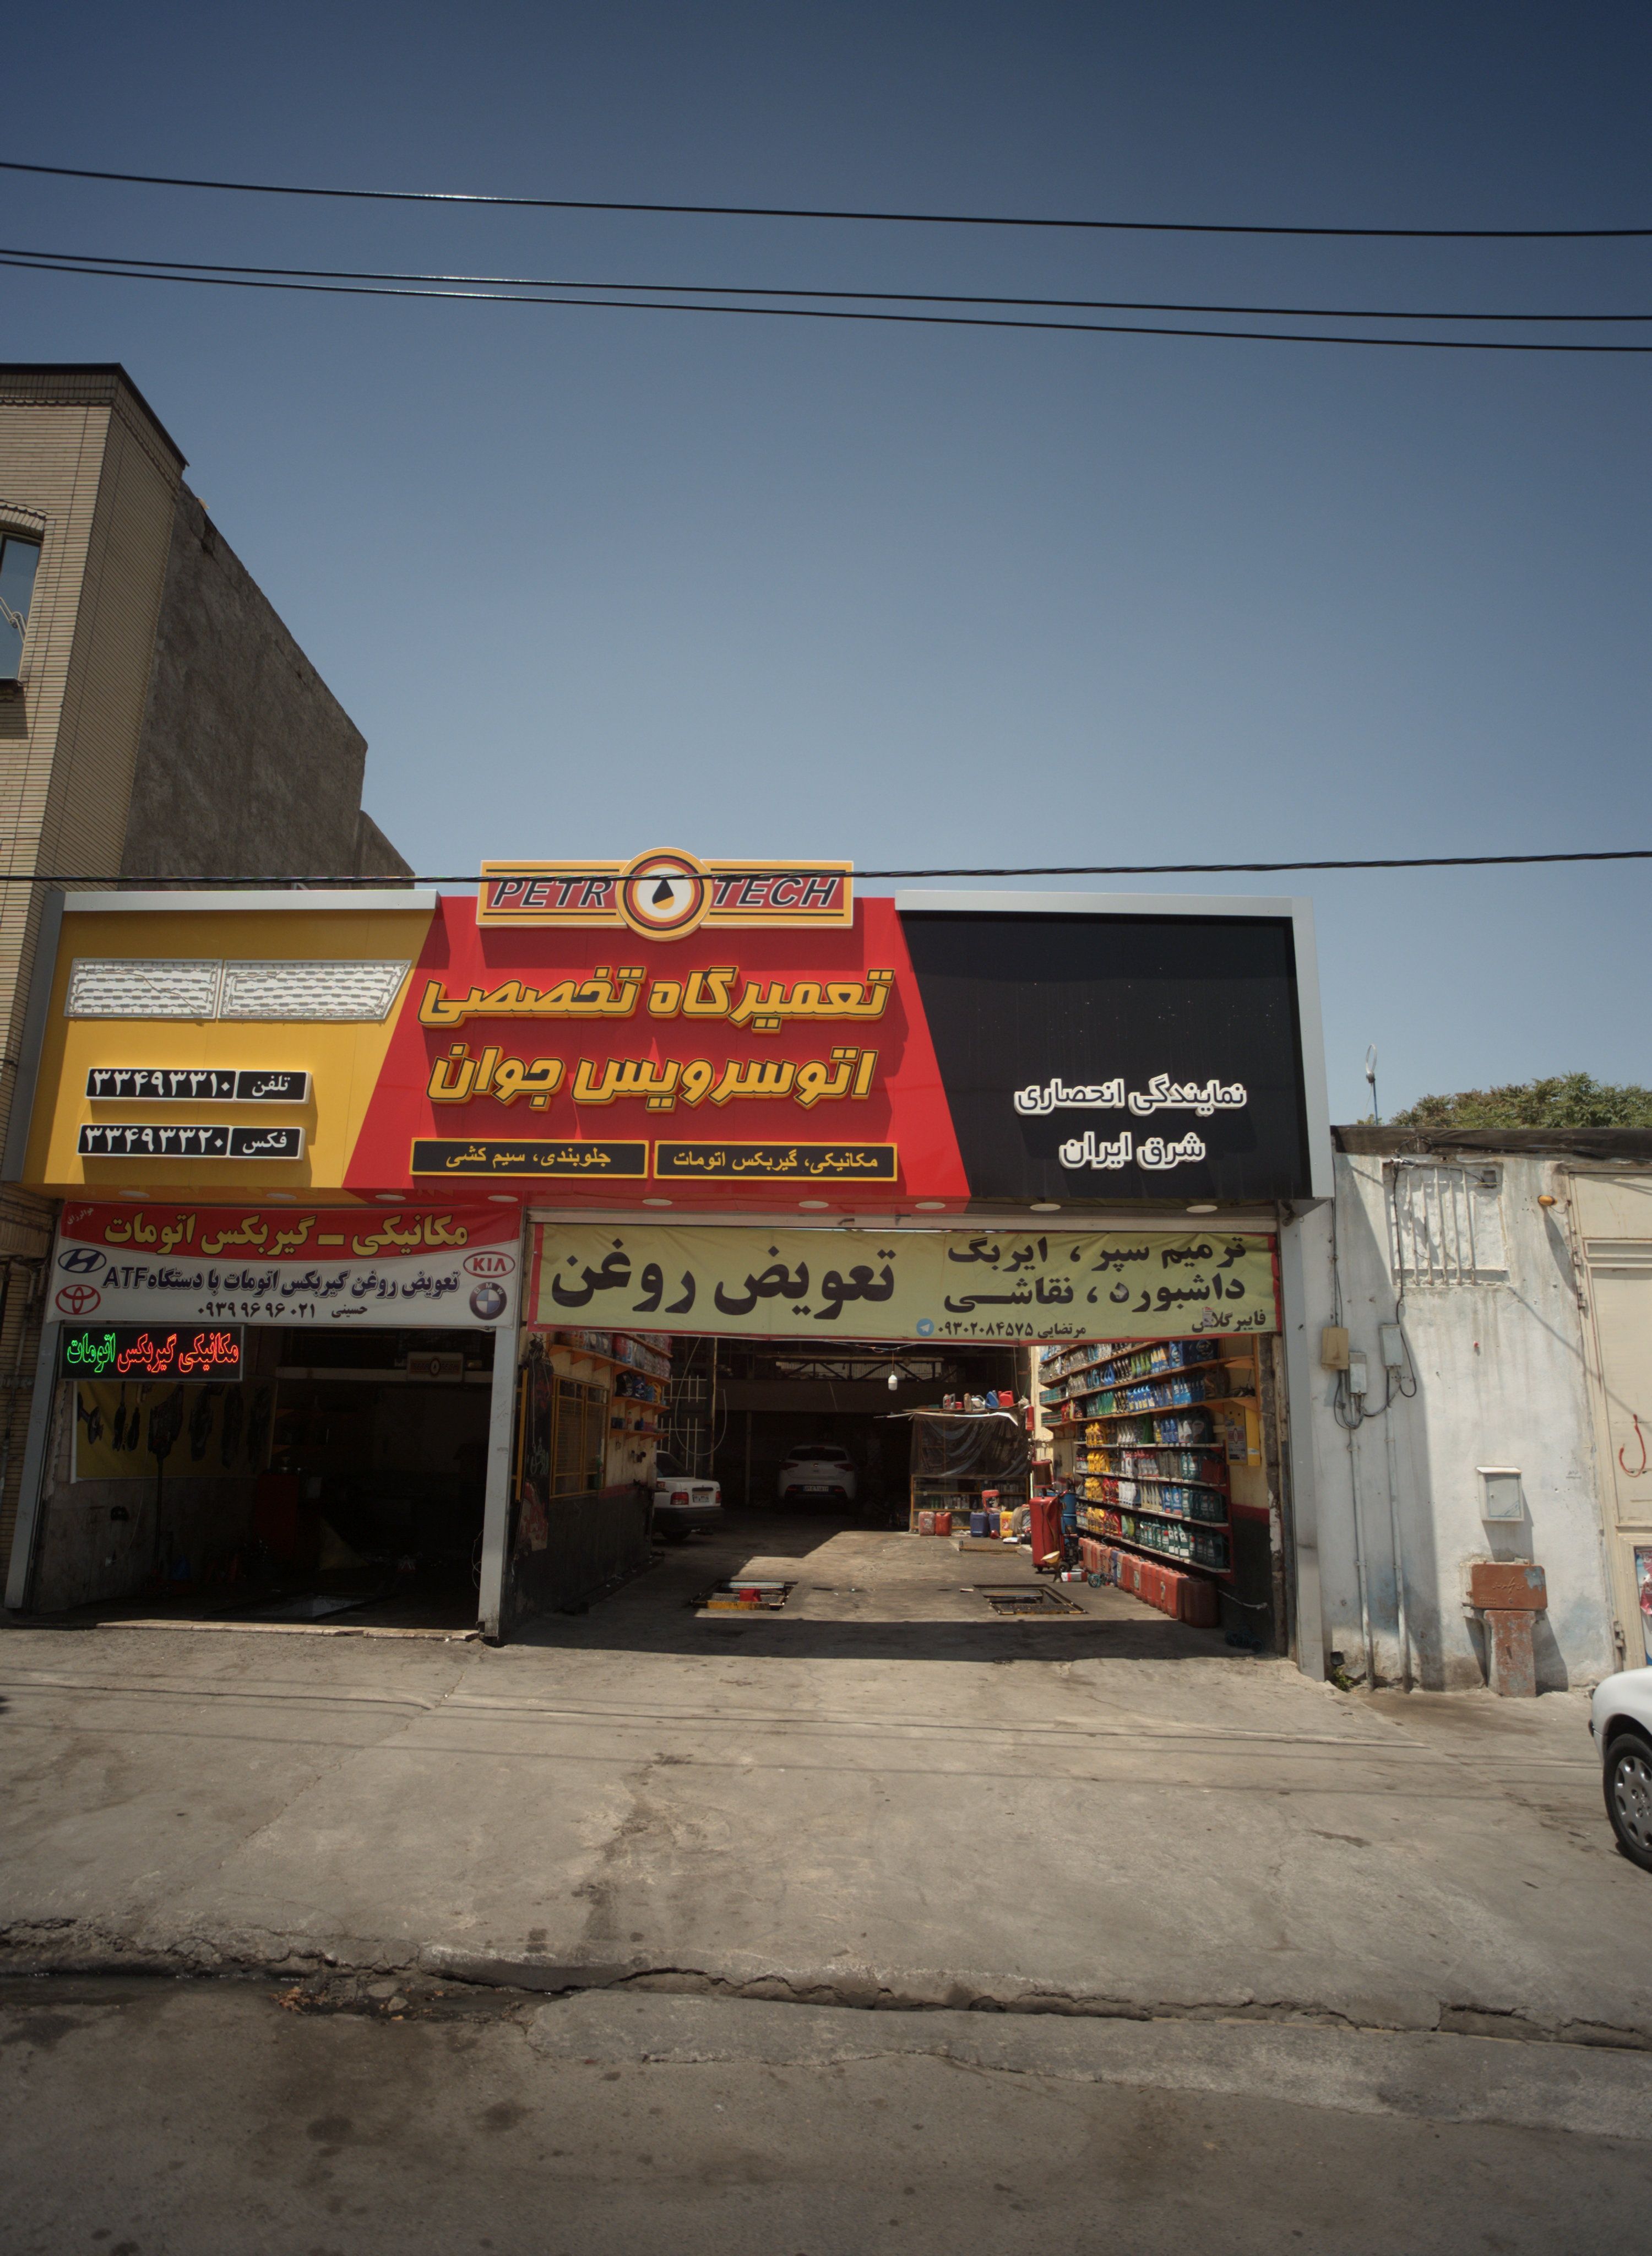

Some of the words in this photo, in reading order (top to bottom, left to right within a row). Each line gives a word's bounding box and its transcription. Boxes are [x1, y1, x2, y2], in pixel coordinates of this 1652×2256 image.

[713, 875, 841, 908] TECH
[417, 966, 646, 1028] تخصصی
[646, 966, 895, 1034] تعمیرگاه
[92, 1070, 231, 1098] ۳۳۴۹۳۳۱۰
[251, 1076, 291, 1097] تلفن
[426, 1042, 567, 1111] جوان
[1013, 1078, 1126, 1116] انحصاری
[1128, 1073, 1247, 1117] نمایندگی
[85, 1127, 224, 1153] ۳۳۴۹۳۳۲۰
[242, 1132, 287, 1153] فکس
[1058, 1131, 1132, 1169] ایران
[1137, 1131, 1205, 1170] شرق
[445, 1146, 487, 1168] کشی
[492, 1152, 526, 1168] سیم
[672, 1152, 726, 1169] اتومات
[732, 1148, 797, 1172] گیربکس
[103, 1211, 197, 1255] اتومات
[200, 1214, 317, 1256] گیربکس
[351, 1213, 469, 1256] مکانیکی
[472, 1257, 507, 1272] KIA
[948, 1237, 1048, 1272] ایربگ
[1161, 1236, 1247, 1269] ترمیم
[102, 1266, 149, 1288] ATF
[147, 1267, 203, 1290] دستگاه
[207, 1268, 222, 1296] با
[224, 1267, 280, 1297] اتومات
[280, 1268, 351, 1299] گیربکس
[351, 1270, 396, 1298] روغن
[402, 1270, 461, 1299] تعویض
[473, 1282, 505, 1295] BMW
[551, 1238, 696, 1314] روغن
[713, 1245, 897, 1320] تعویض
[943, 1277, 1074, 1313] نقاشی
[332, 1304, 368, 1318] حسینی
[1233, 1309, 1267, 1332] فایبر
[938, 1321, 1034, 1337] ۰۹۳۰۲۰۸۴۵۷۵
[1037, 1322, 1086, 1338] مرتضایی
[67, 1332, 116, 1373] اتومات
[117, 1333, 177, 1373] گیربکس
[178, 1332, 239, 1373] مکانیکی
